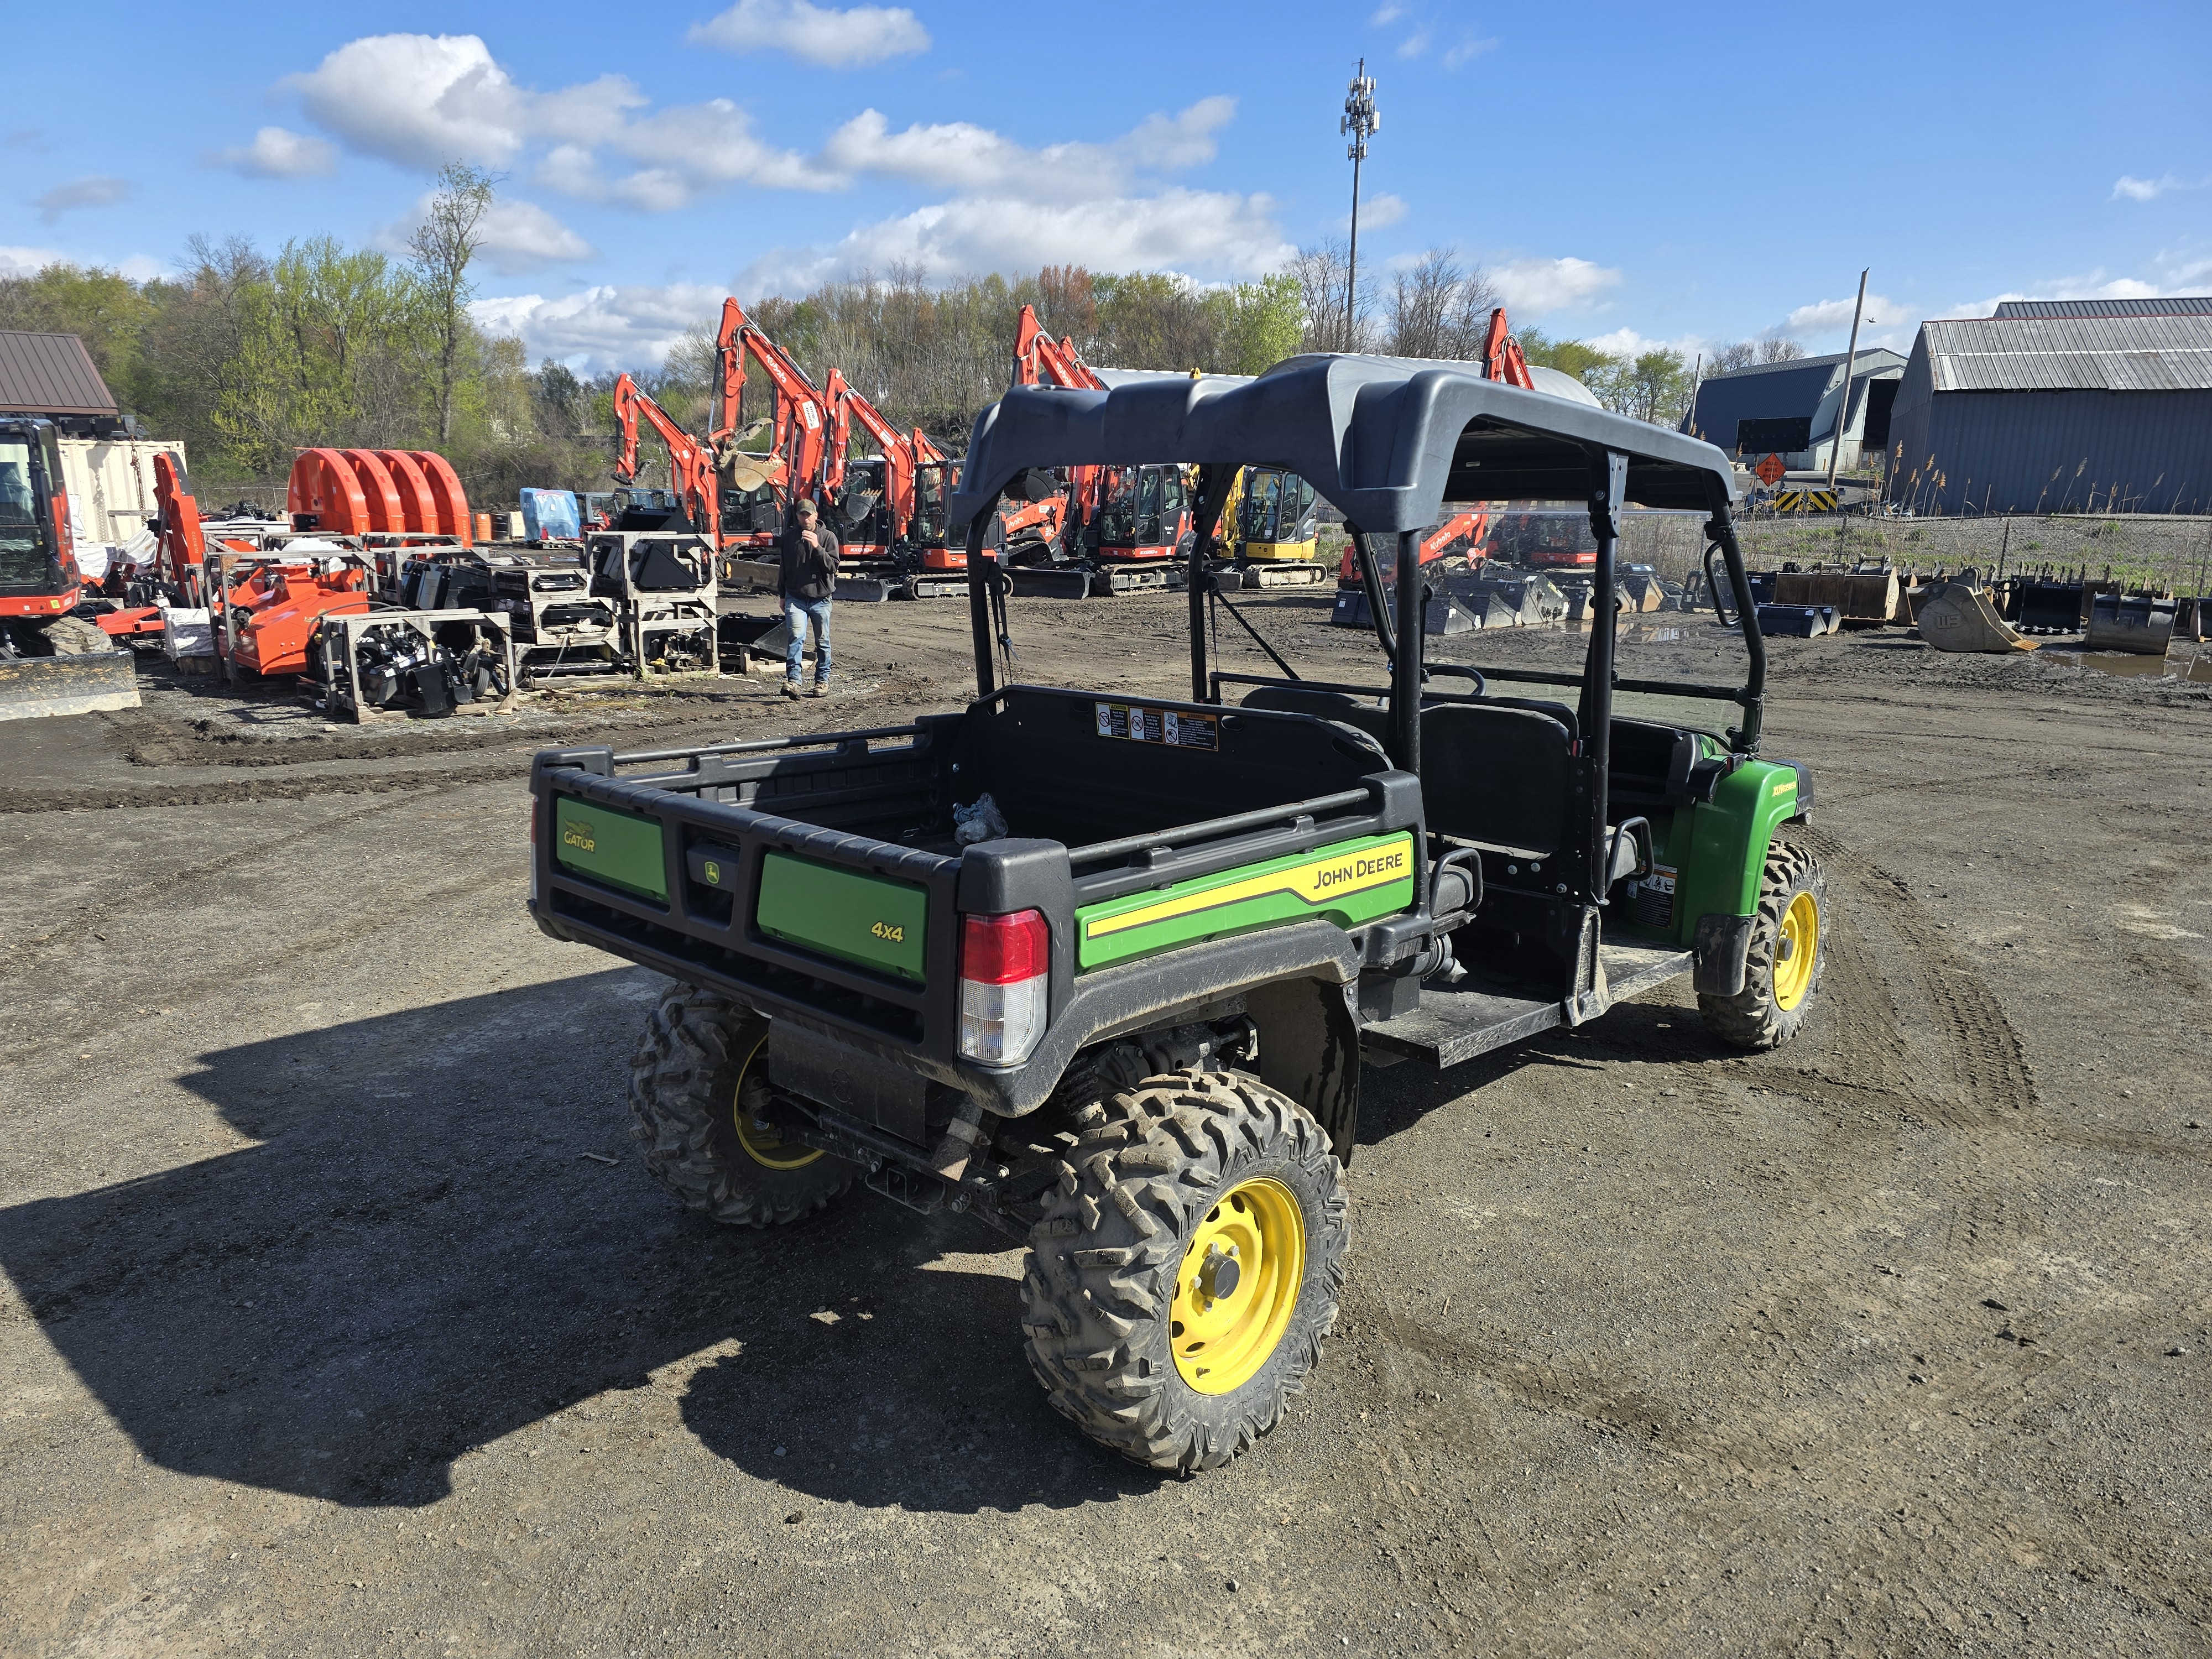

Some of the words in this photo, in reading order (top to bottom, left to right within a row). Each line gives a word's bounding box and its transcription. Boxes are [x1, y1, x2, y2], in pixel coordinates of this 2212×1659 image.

[766, 354, 787, 383] Kubota
[1006, 517, 1024, 529] ubota
[1430, 531, 1451, 550] Kubota
[564, 830, 596, 853] GATOR
[1313, 865, 1353, 890] JOHN
[1357, 853, 1402, 878] DEERE
